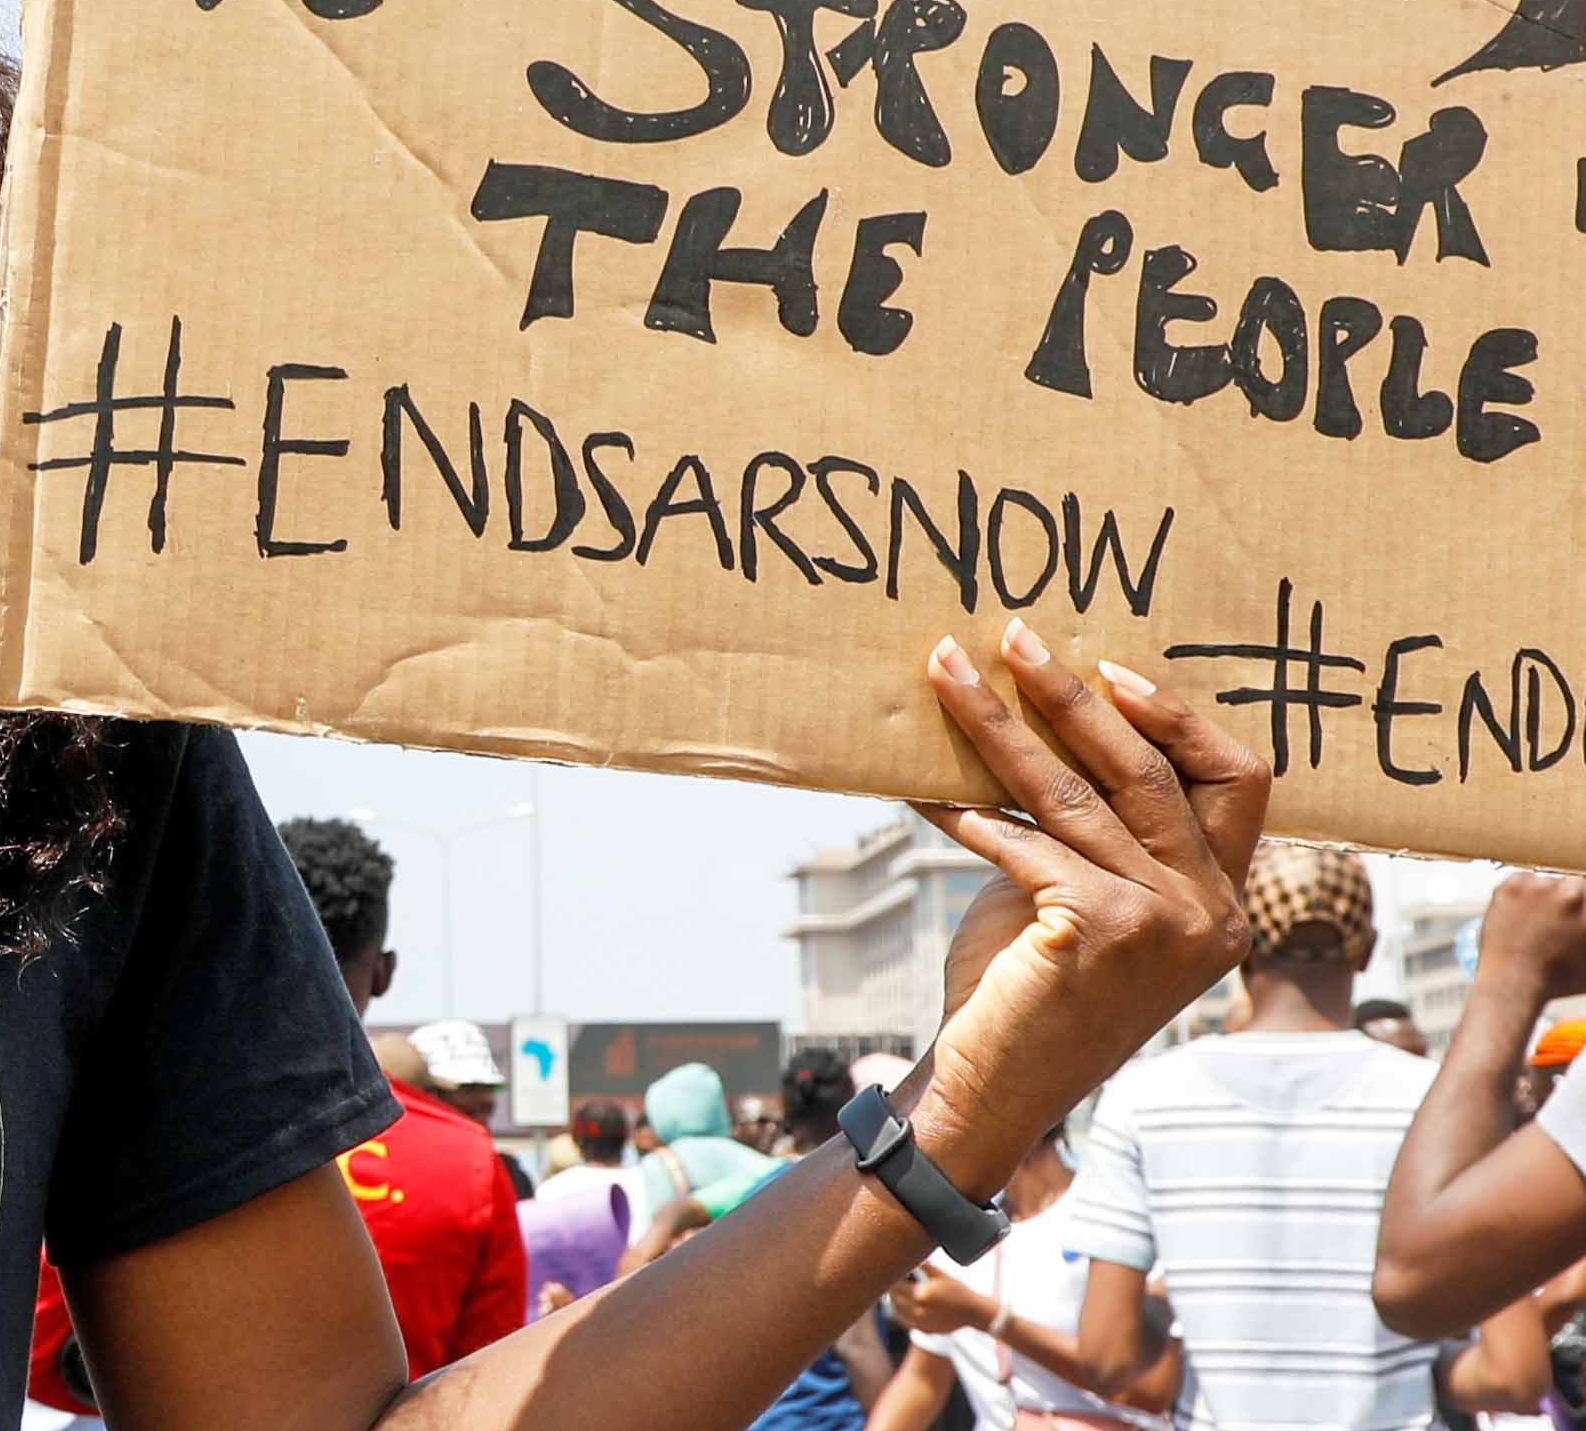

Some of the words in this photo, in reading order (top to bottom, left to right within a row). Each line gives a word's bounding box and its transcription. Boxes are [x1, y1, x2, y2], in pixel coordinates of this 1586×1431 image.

[470, 159, 927, 356] THE
[1025, 210, 1543, 464] PEOPLE
[23, 315, 1175, 619] #ENDSARSNOW
